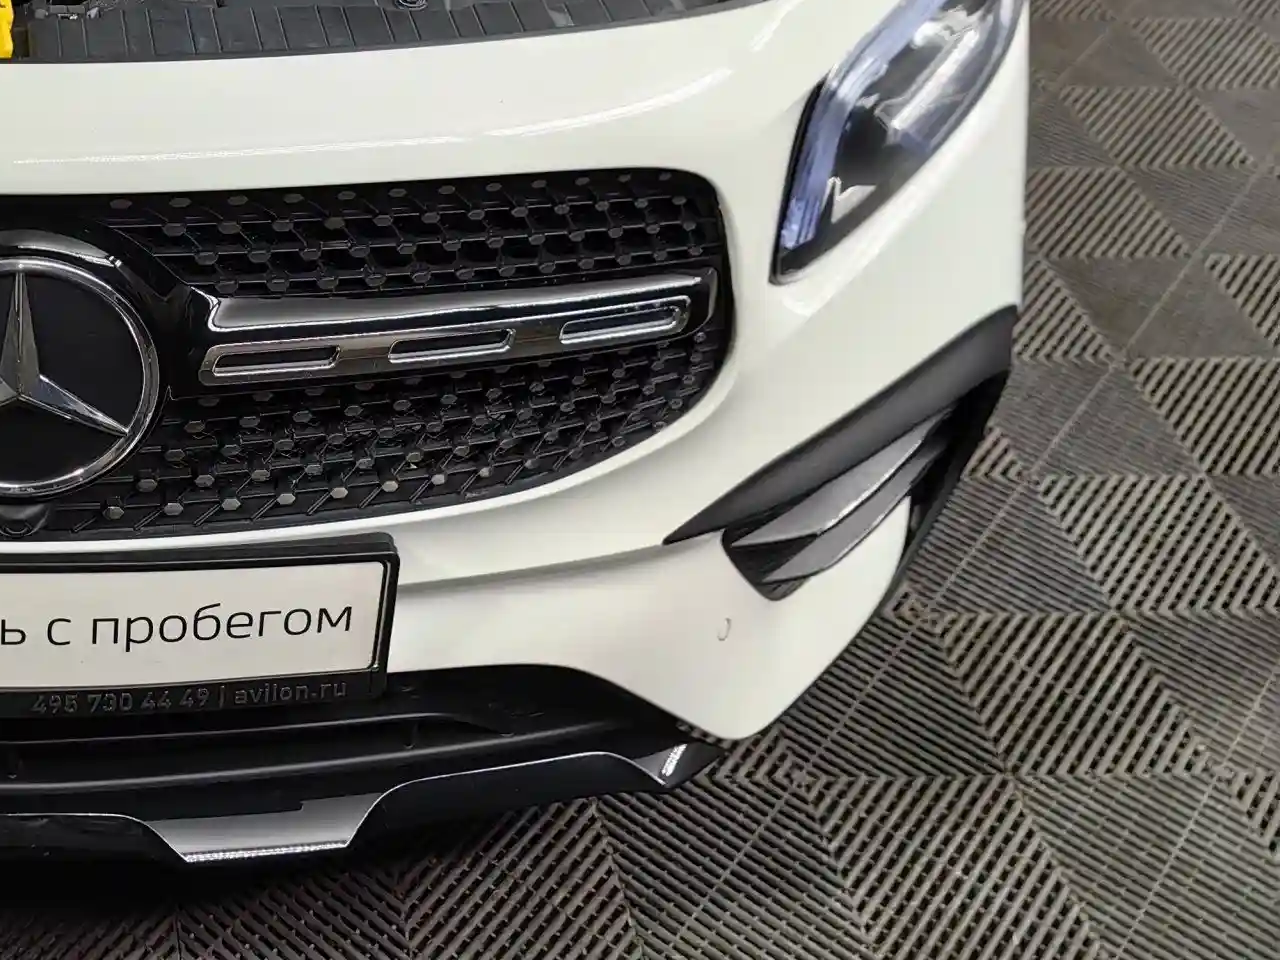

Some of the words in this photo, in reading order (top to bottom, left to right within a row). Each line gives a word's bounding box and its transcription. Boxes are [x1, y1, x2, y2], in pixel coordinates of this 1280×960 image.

[47, 617, 72, 647] с
[91, 602, 353, 653] пробегом
[31, 693, 79, 715] 495
[87, 692, 133, 713] 730
[140, 691, 172, 711] 44
[179, 688, 210, 709] 49
[234, 681, 348, 705] avilon.ru
